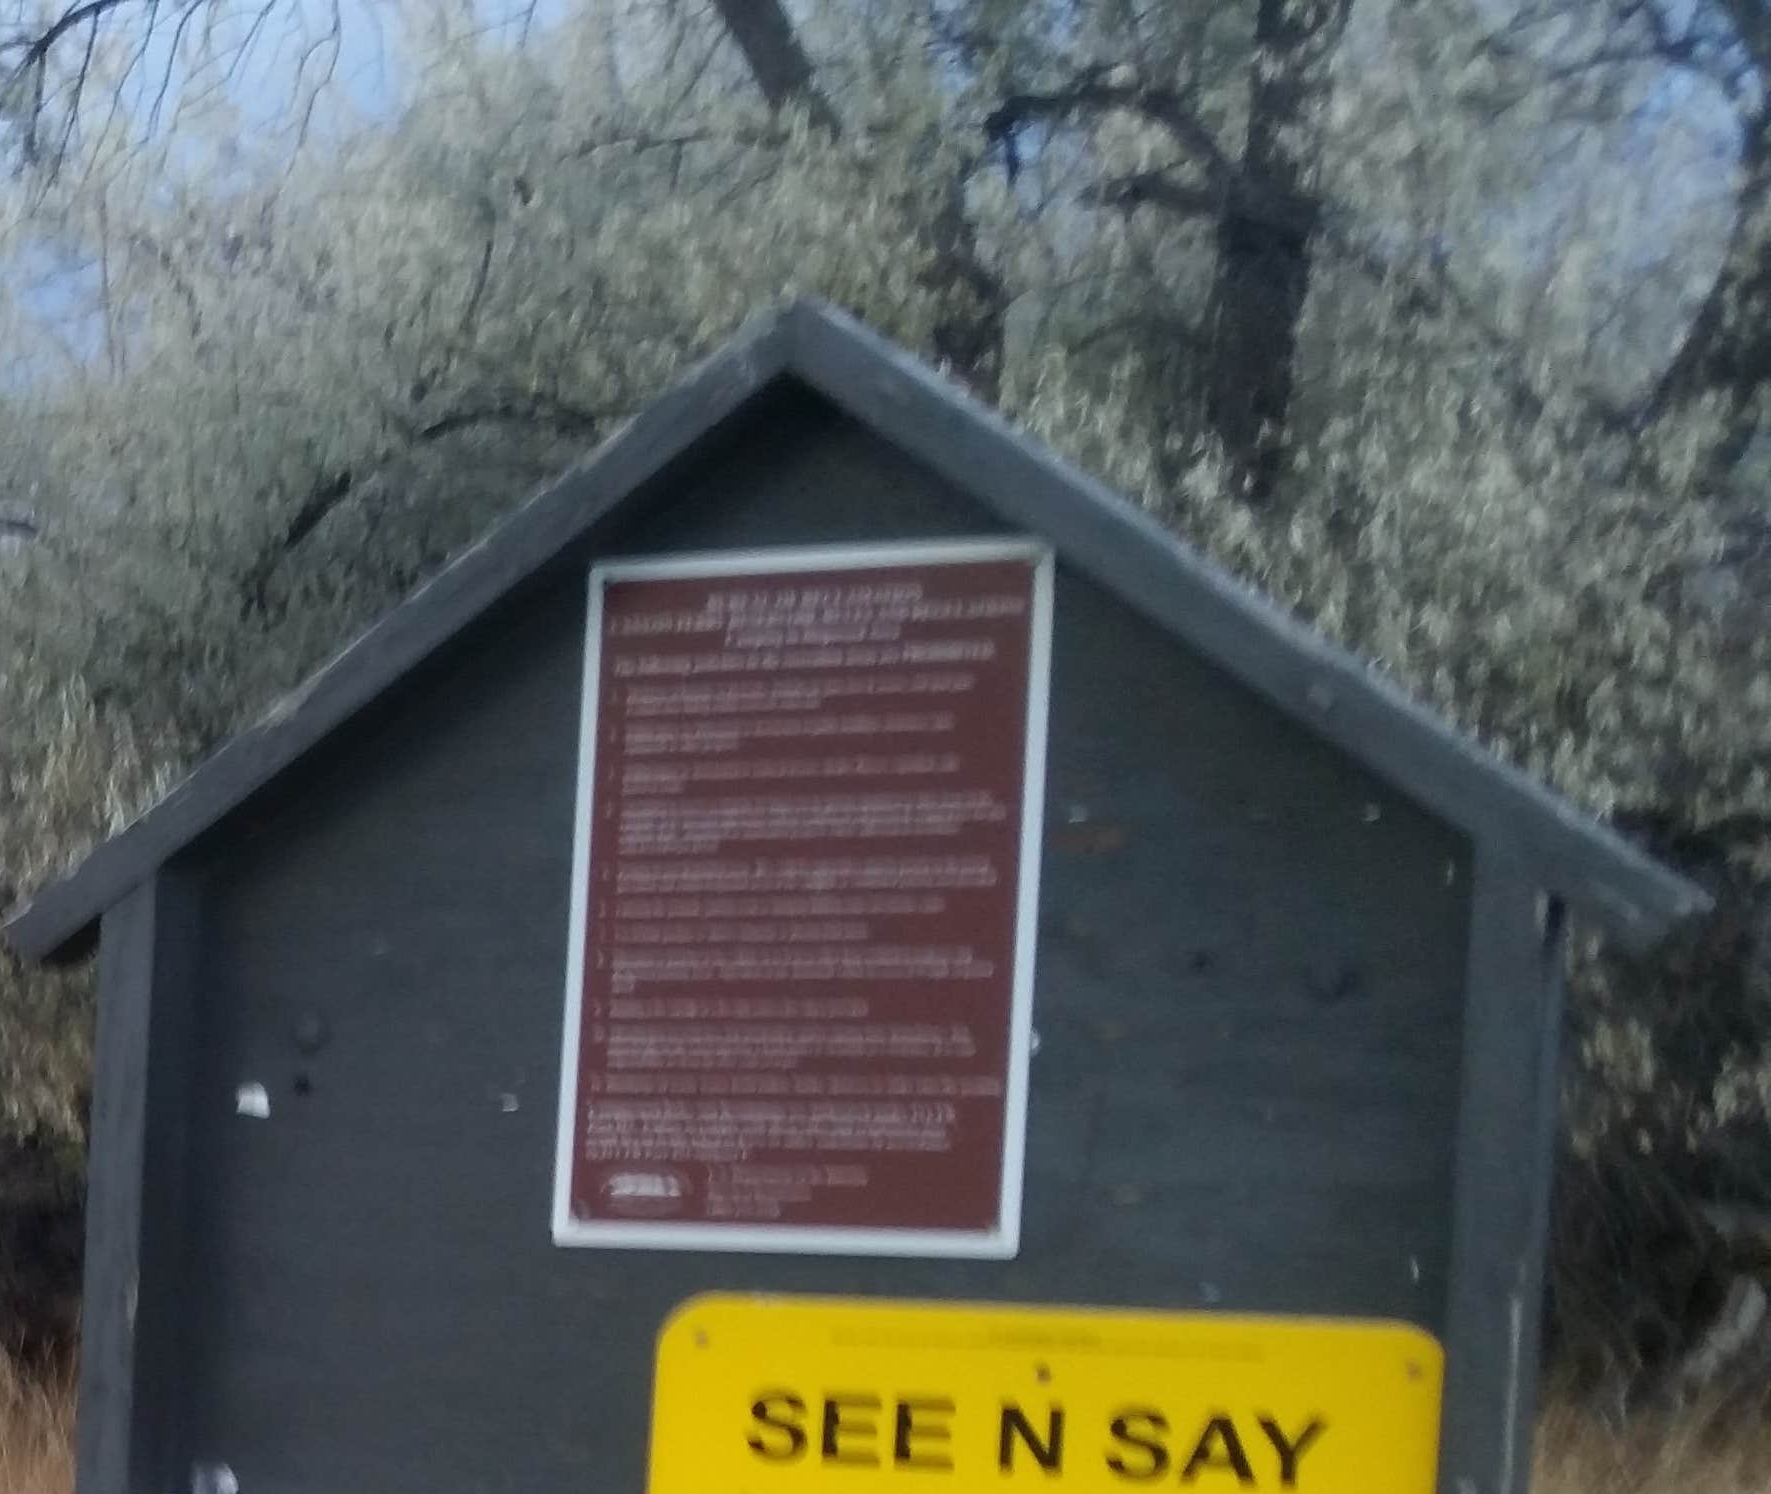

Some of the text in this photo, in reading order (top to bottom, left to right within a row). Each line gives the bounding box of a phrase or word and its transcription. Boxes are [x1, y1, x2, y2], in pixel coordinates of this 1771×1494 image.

[747, 1388, 1326, 1492] SEE N SAY
